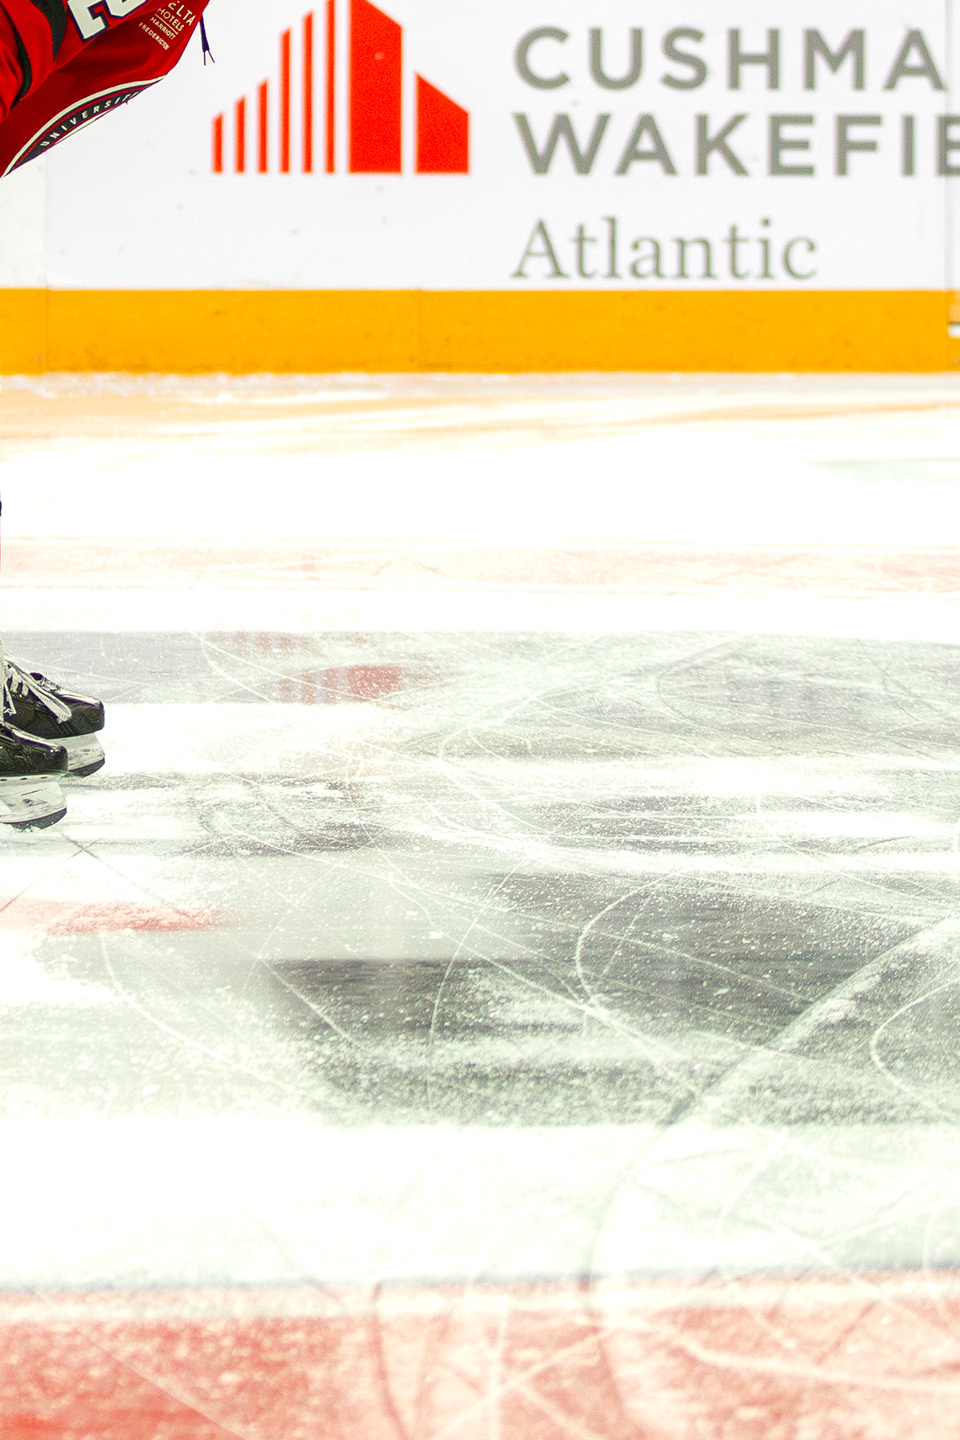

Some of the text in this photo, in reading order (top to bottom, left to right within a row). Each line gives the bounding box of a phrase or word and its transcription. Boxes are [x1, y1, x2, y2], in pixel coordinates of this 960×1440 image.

[157, 7, 185, 32] HOTELS
[167, 0, 196, 27] ELTA
[509, 217, 819, 280] Atlantic
